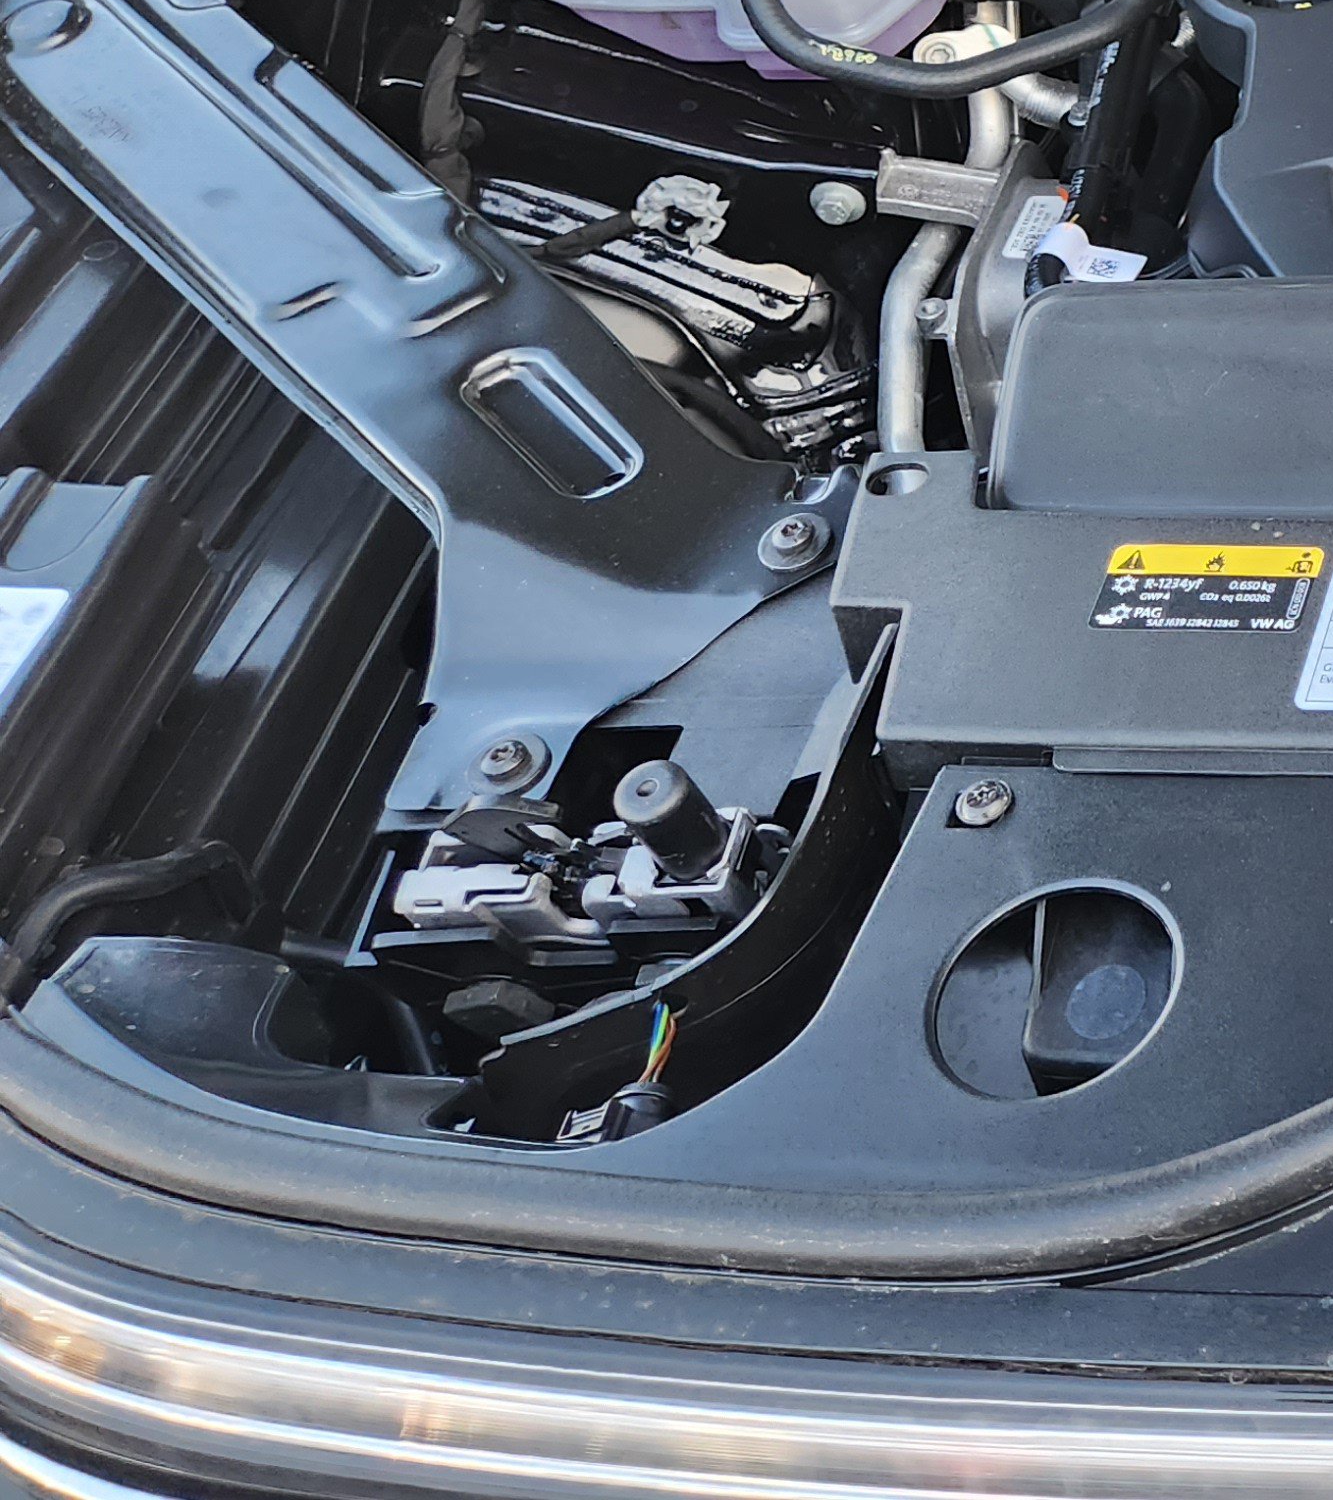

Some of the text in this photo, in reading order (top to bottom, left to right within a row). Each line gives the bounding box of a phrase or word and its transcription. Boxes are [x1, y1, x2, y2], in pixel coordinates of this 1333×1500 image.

[1144, 578, 1204, 591] R-1234yf
[1261, 580, 1277, 593] kg
[1134, 606, 1163, 618] PAG
[1145, 618, 1163, 627] SAE
[1250, 619, 1275, 629] VW
[1275, 619, 1295, 630] AG
